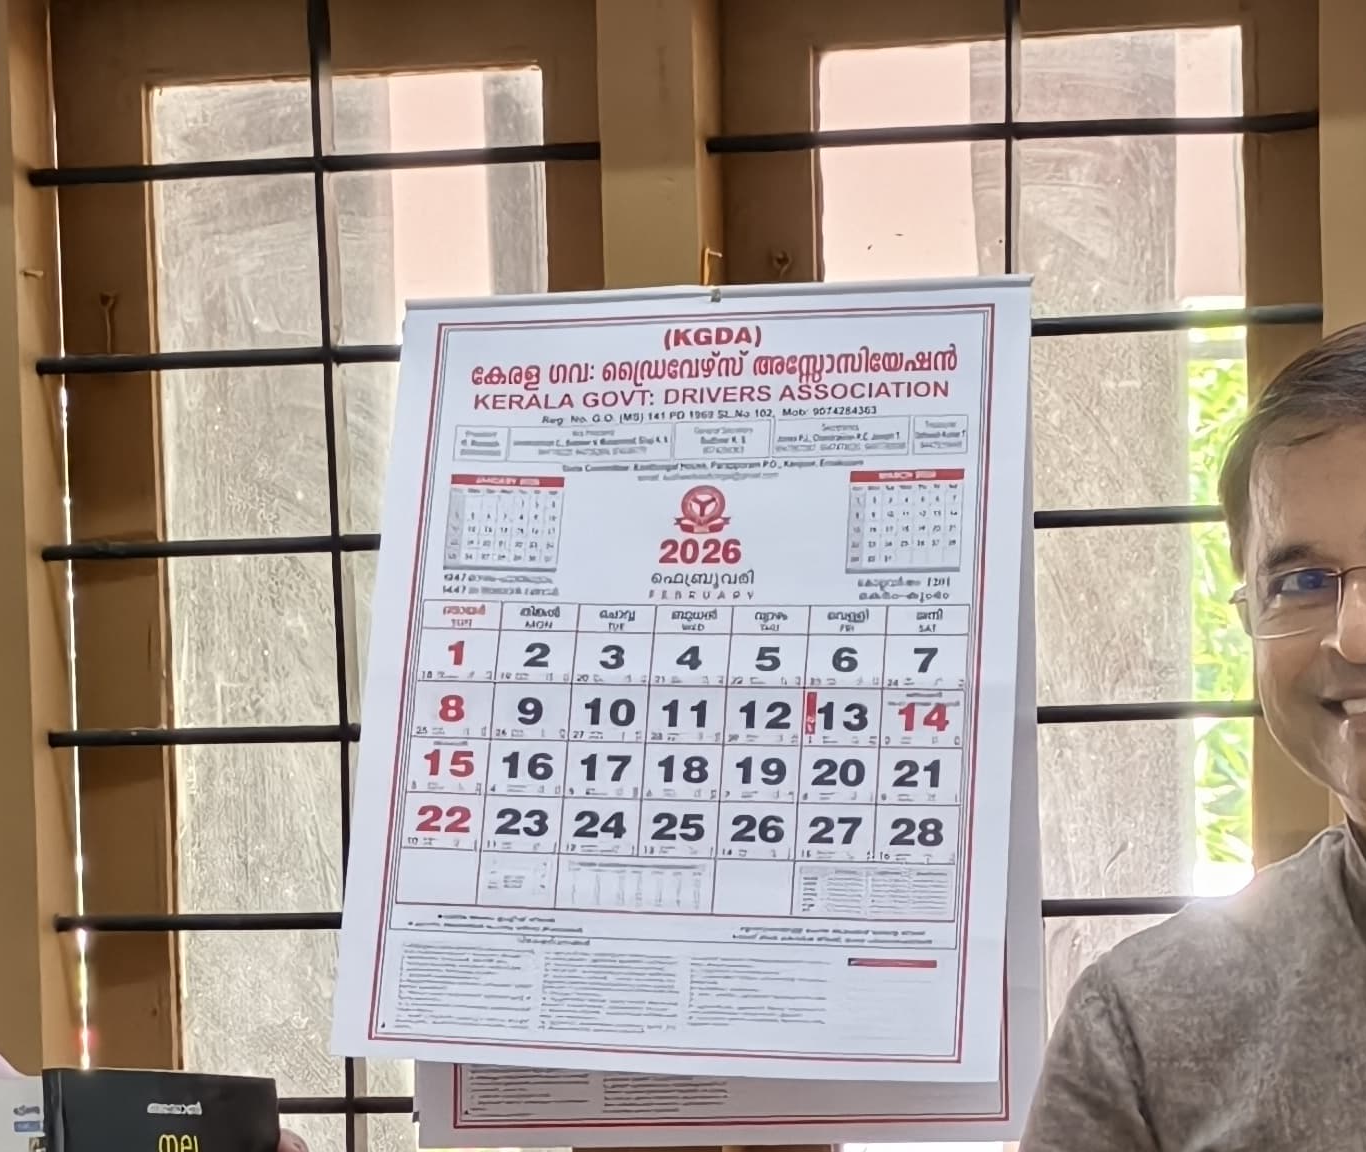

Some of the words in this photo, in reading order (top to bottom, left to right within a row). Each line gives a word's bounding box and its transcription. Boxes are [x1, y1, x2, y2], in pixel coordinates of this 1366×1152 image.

[664, 325, 762, 351] (KGDA)
[472, 364, 540, 391] കേരള
[549, 362, 595, 385] ഗവ:
[602, 350, 749, 387] ഡ്രൈവേഴ്സ്
[753, 343, 957, 384] അസ്സോസിയേഷൻ
[473, 393, 574, 410] KERALA
[582, 390, 655, 408] GOVT:
[664, 385, 771, 405] DRIVERS
[779, 380, 950, 402] ASSOCIATION
[648, 412, 665, 421] 141
[658, 538, 742, 564] 2026
[651, 569, 755, 589] ഫെബ്രുവരി
[447, 640, 465, 666] 1
[523, 642, 551, 668] 2
[598, 644, 625, 670] 3
[675, 645, 702, 671] 4
[755, 646, 782, 672] 5
[832, 647, 858, 673] 6
[913, 647, 938, 673] 7
[438, 694, 465, 722] 8
[517, 696, 543, 725] 9
[584, 697, 636, 727] 10
[662, 699, 707, 728] 11
[739, 700, 792, 730] 12
[817, 701, 868, 732] 13
[898, 702, 950, 732] 14
[572, 730, 585, 739] 27
[424, 748, 475, 778] 15
[502, 751, 554, 780] 16
[580, 753, 632, 782] 17
[657, 754, 709, 783] 18
[735, 756, 787, 786] 19
[810, 758, 866, 787] 20
[892, 759, 941, 788] 21
[415, 804, 472, 833] 22
[494, 807, 549, 837] 23
[573, 810, 627, 839] 24
[650, 812, 705, 842] 25
[730, 814, 785, 843] 26
[808, 816, 863, 845] 27
[889, 817, 944, 847] 28
